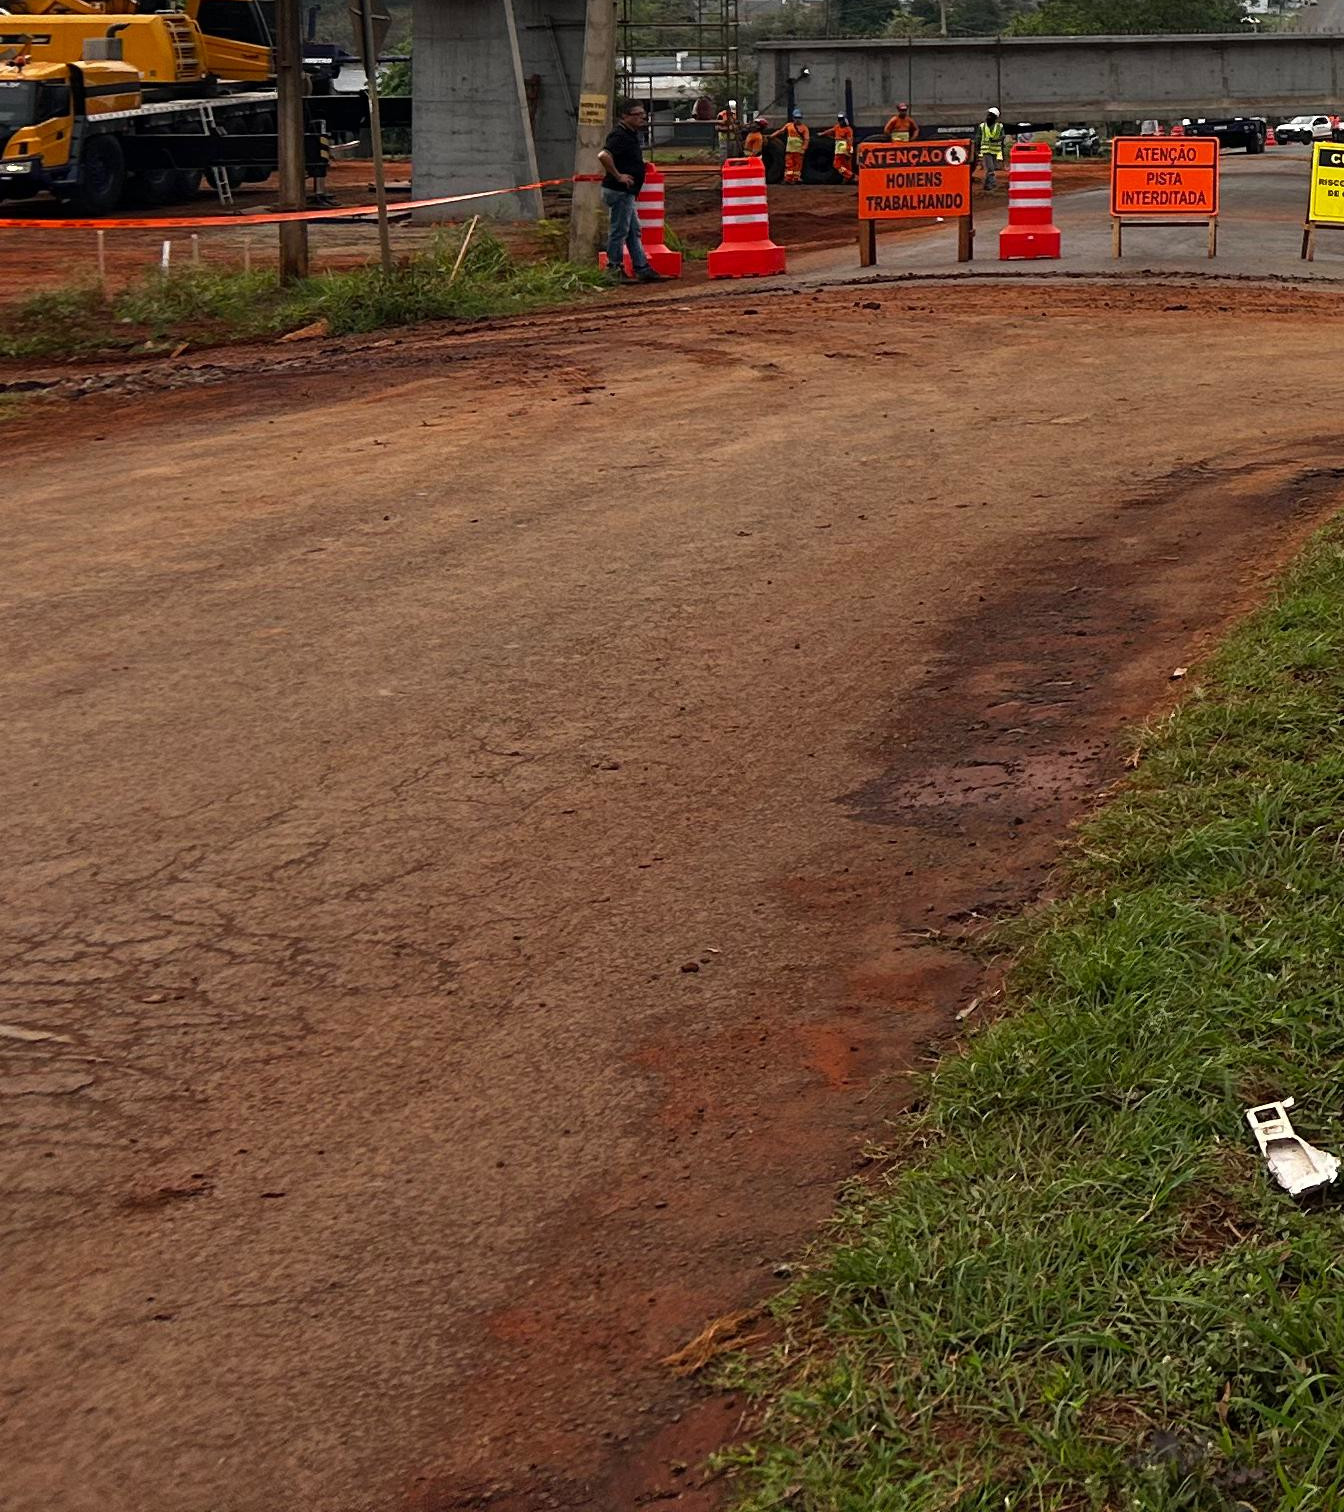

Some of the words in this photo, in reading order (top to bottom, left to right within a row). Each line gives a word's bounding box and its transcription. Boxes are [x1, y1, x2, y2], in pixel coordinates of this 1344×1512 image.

[864, 148, 943, 166] ATENÇÃO
[1134, 144, 1197, 165] ATENÇÃO
[886, 171, 943, 189] HOMENS
[1146, 172, 1183, 185] PISTA
[866, 193, 963, 211] TRABALHANDO
[1121, 190, 1207, 205] INTERDITADA
[1327, 190, 1340, 198] DE
